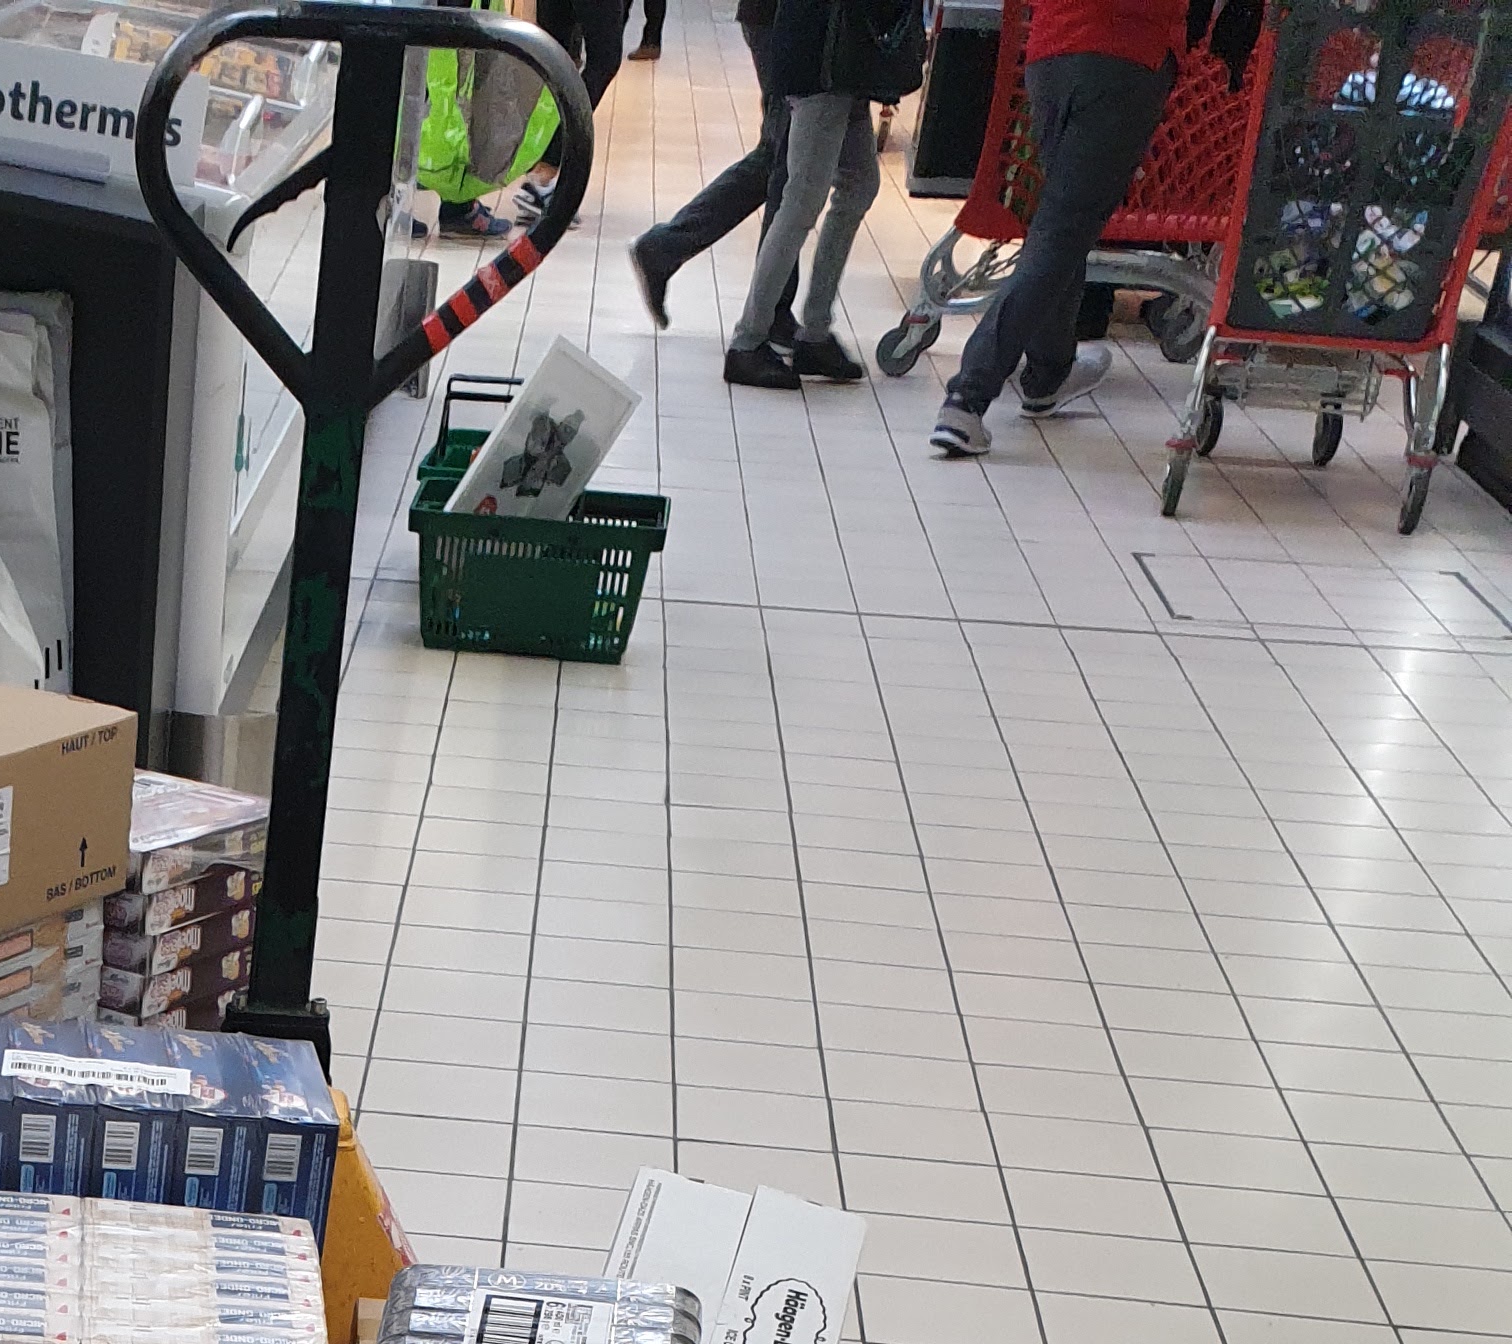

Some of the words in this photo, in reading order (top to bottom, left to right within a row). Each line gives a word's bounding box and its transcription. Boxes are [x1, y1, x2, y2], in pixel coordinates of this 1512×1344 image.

[61, 735, 89, 756] HAUT
[98, 726, 119, 745] TOP
[46, 882, 67, 901] BAS
[74, 864, 117, 891] BOTTOM
[727, 1328, 738, 1344] ICE
